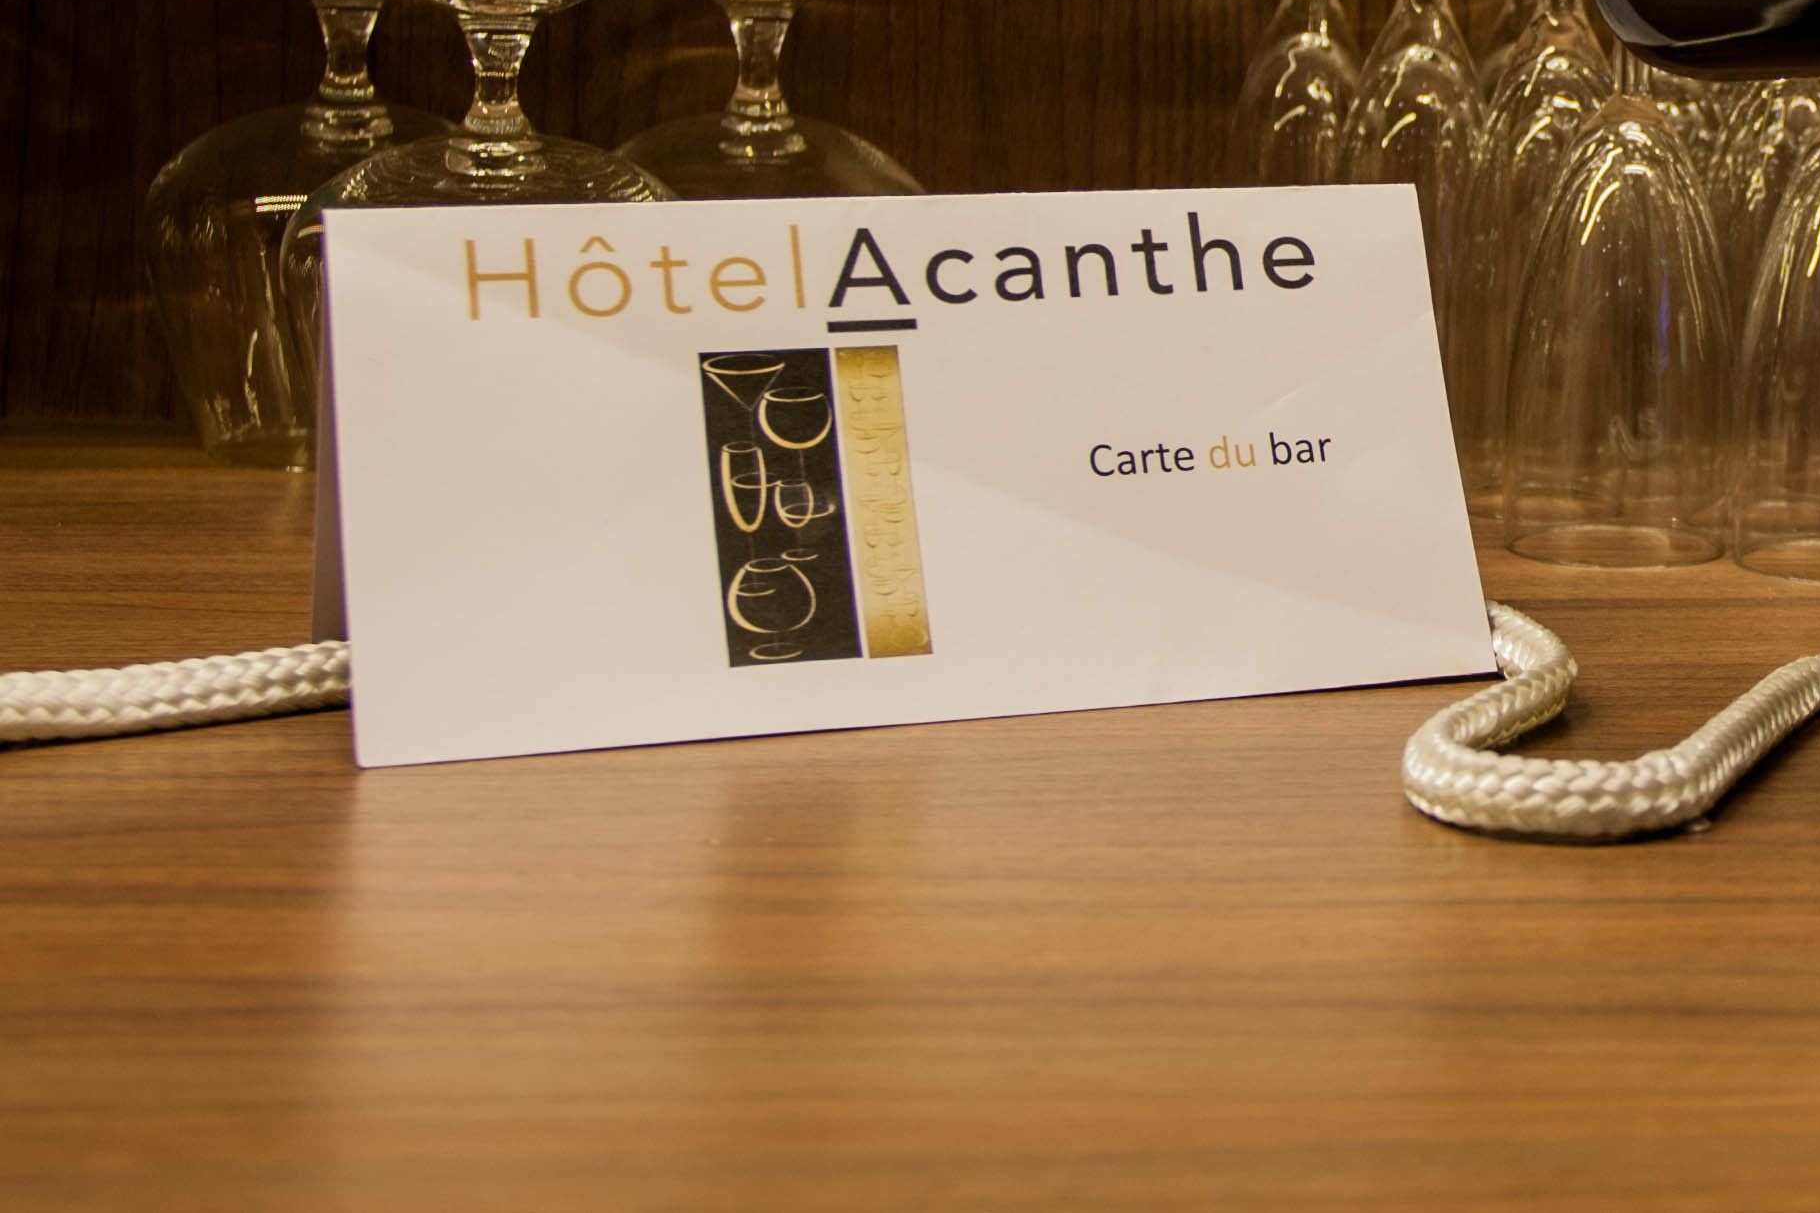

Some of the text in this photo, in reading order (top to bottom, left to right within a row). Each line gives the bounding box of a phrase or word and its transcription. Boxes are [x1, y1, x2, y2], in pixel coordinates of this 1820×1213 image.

[464, 211, 1316, 321] Hôtel Acanthe
[1089, 431, 1332, 476] Carte du bar
